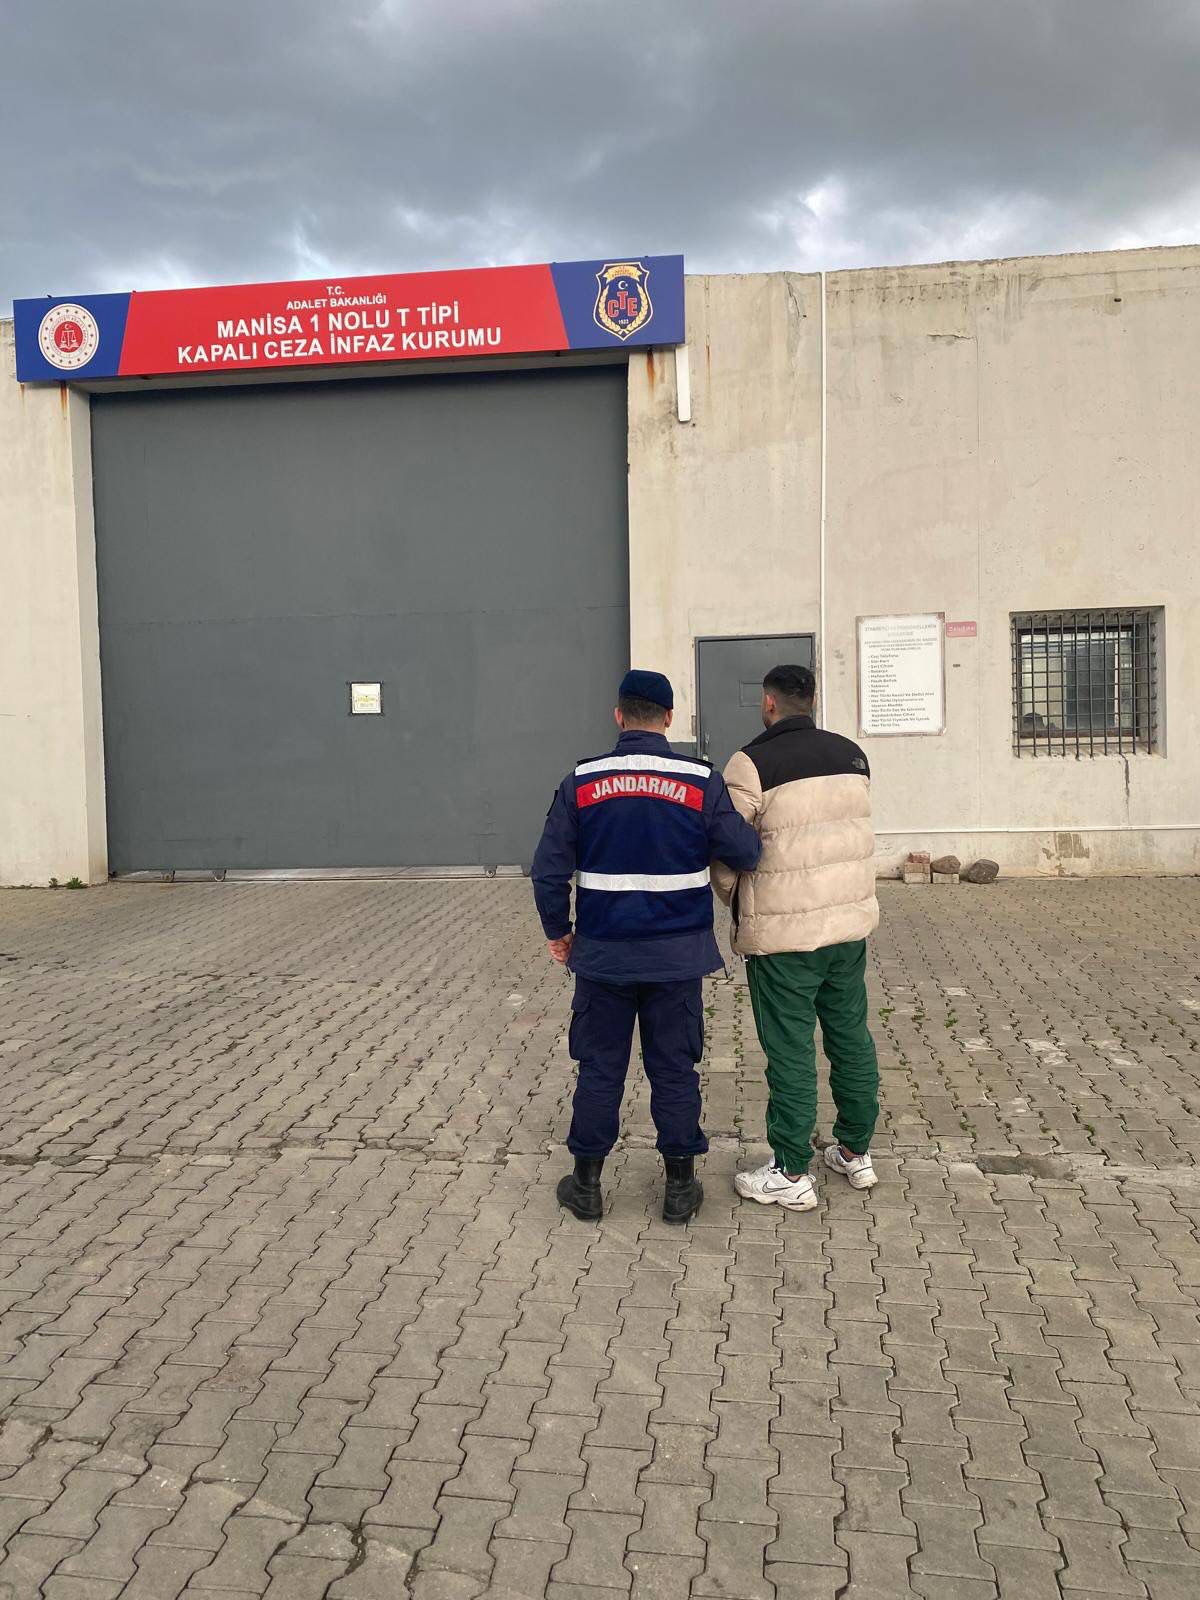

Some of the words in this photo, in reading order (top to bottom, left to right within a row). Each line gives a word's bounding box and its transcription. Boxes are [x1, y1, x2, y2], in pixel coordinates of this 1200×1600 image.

[286, 299, 328, 310] ADALET
[329, 292, 387, 308] BAKANLIĞI
[326, 286, 345, 296] T.C.
[607, 290, 638, 318] CTE
[217, 312, 303, 339] MANİSA
[310, 313, 319, 332] 1
[328, 309, 390, 332] NOLU
[396, 307, 410, 327] T
[416, 300, 460, 326] TİPİ
[177, 341, 258, 364] KAPALI
[263, 337, 324, 359] CEZA
[329, 333, 396, 355] İNFAZ
[402, 326, 502, 351] KURUMU
[592, 776, 687, 803] JANDARMA
